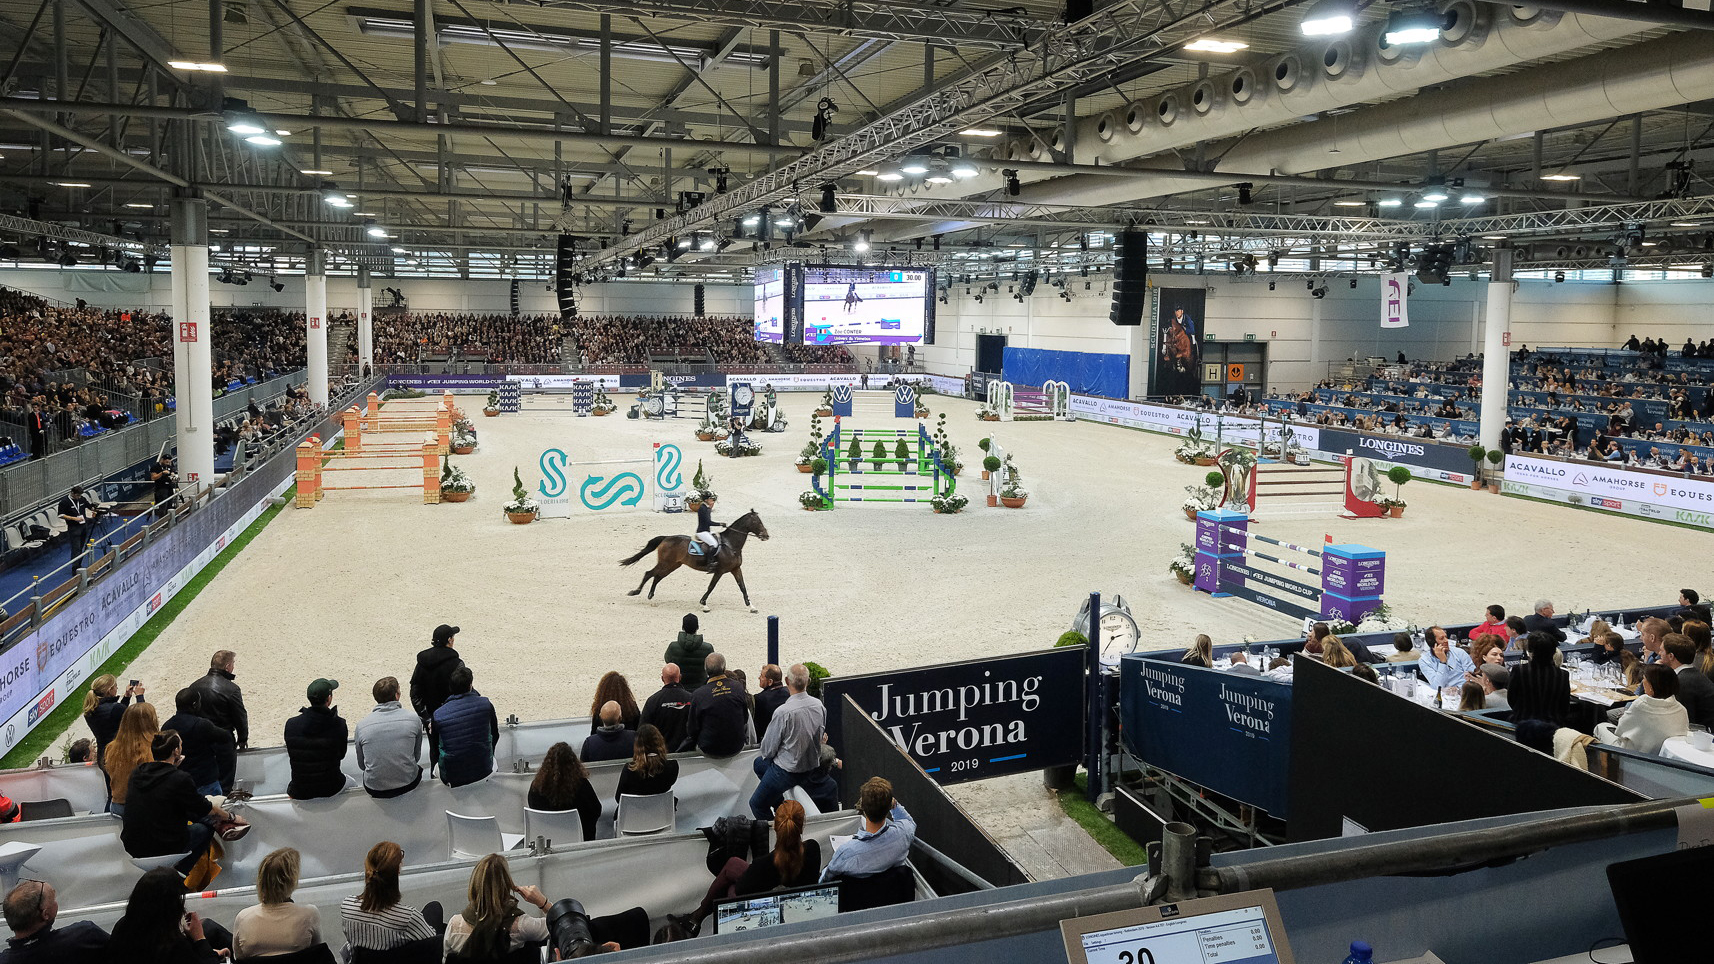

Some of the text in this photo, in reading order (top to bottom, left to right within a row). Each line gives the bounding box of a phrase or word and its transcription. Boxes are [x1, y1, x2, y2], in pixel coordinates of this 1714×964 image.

[1388, 277, 1400, 322] FEI
[1209, 368, 1218, 379] H
[1073, 398, 1098, 406] ACAVALLO
[1141, 411, 1170, 419] EQUESTRO
[1359, 437, 1425, 456] LONGINES
[1510, 462, 1566, 477] ACAVALLO
[1592, 475, 1646, 489] AMAHORSE
[672, 498, 677, 506] 3
[1603, 499, 1621, 508] sport
[1676, 510, 1711, 525] KASK
[1226, 563, 1250, 576] LONGINES
[1264, 576, 1284, 588] JUMPING
[1285, 582, 1302, 593] WORLD
[1302, 588, 1313, 596] CUP
[1256, 594, 1277, 607] VERONA
[50, 612, 95, 657] EQUESTRO
[101, 572, 139, 611] ACAVALLO
[1140, 662, 1186, 693] Jumping
[39, 693, 54, 712] sport
[871, 670, 1043, 721] Jumping
[1144, 680, 1182, 706] Verona
[1219, 683, 1275, 720] Jumping
[1224, 703, 1270, 734] Verona
[888, 718, 1028, 757] Verona
[950, 758, 979, 772] 2019
[1215, 940, 1236, 949] penalties
